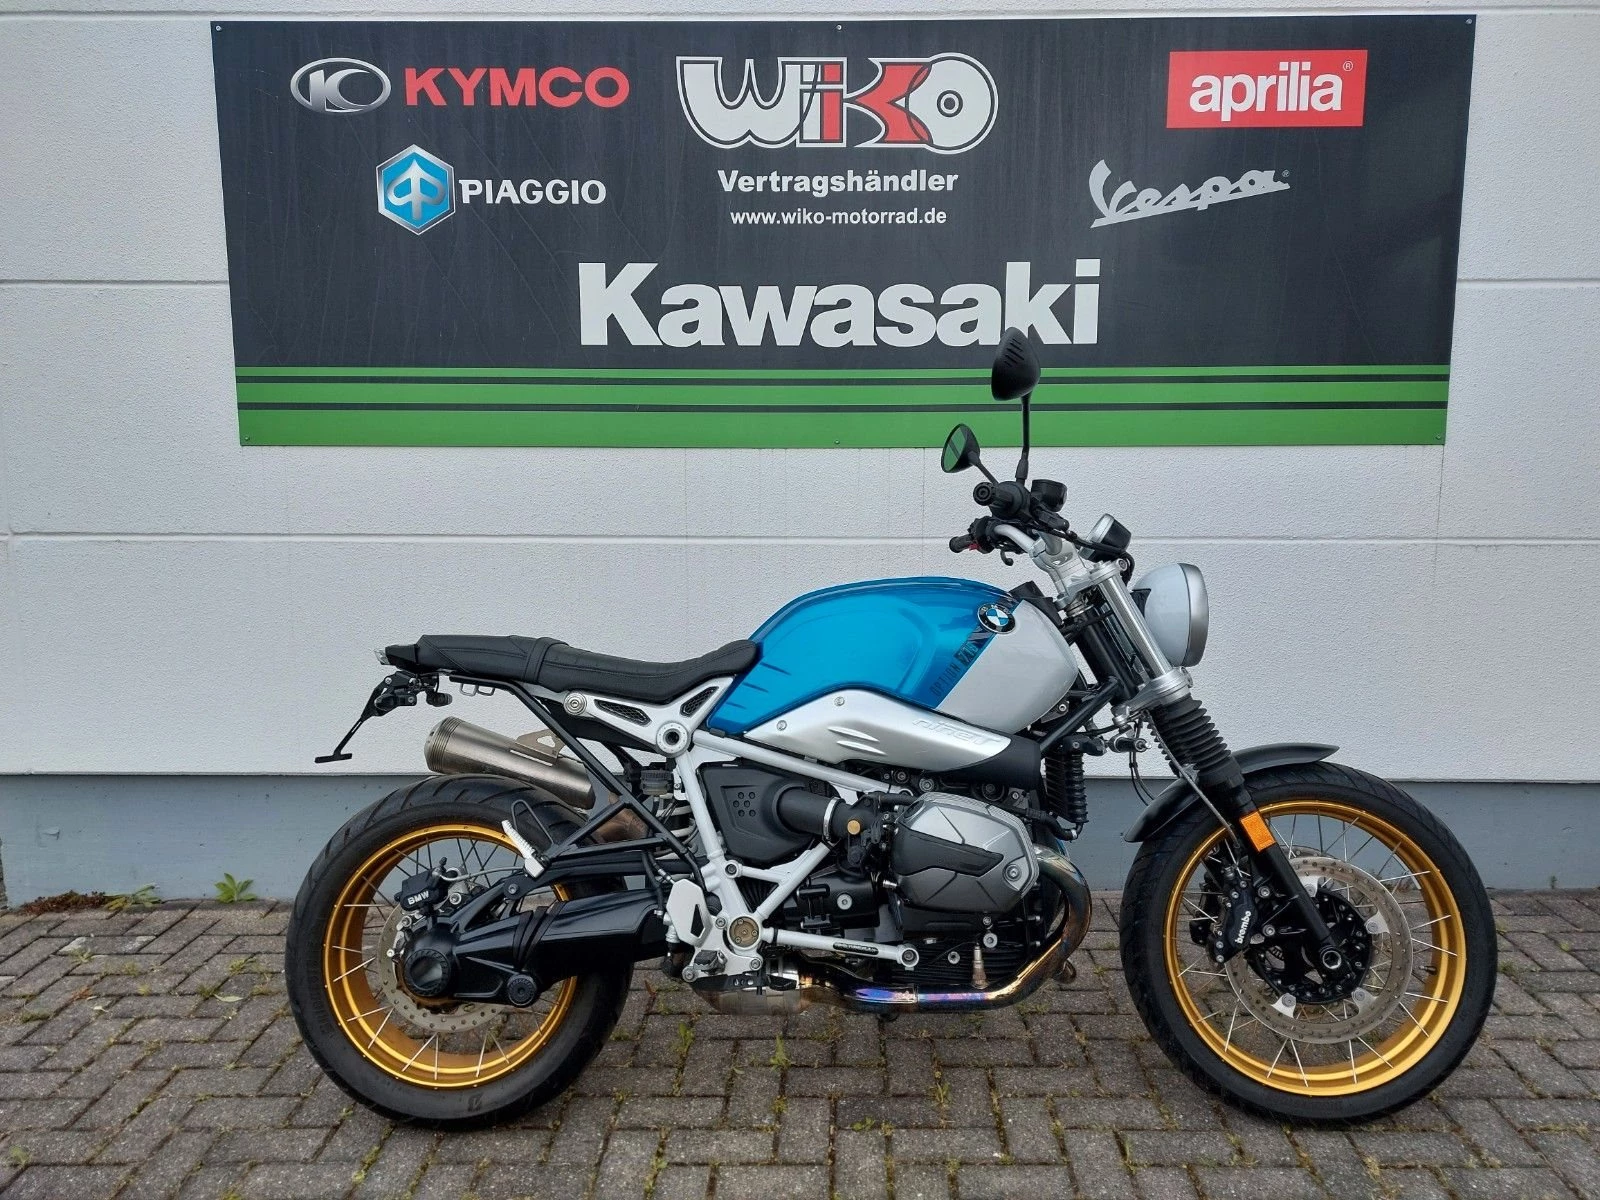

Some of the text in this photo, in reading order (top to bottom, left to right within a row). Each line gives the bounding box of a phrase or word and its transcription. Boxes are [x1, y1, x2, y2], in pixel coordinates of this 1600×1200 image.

[404, 67, 630, 108] KYMCO
[1189, 61, 1343, 122] aprilia
[458, 178, 608, 205] PIAGGIO
[717, 169, 959, 198] Vertragshändler
[1089, 159, 1290, 228] Vespa
[730, 207, 947, 226] www.wiko-motorrad.de
[578, 258, 1101, 348] Kawasaki
[929, 662, 961, 697] OPTION
[407, 890, 430, 905] BMW
[1234, 910, 1252, 944] brembo
